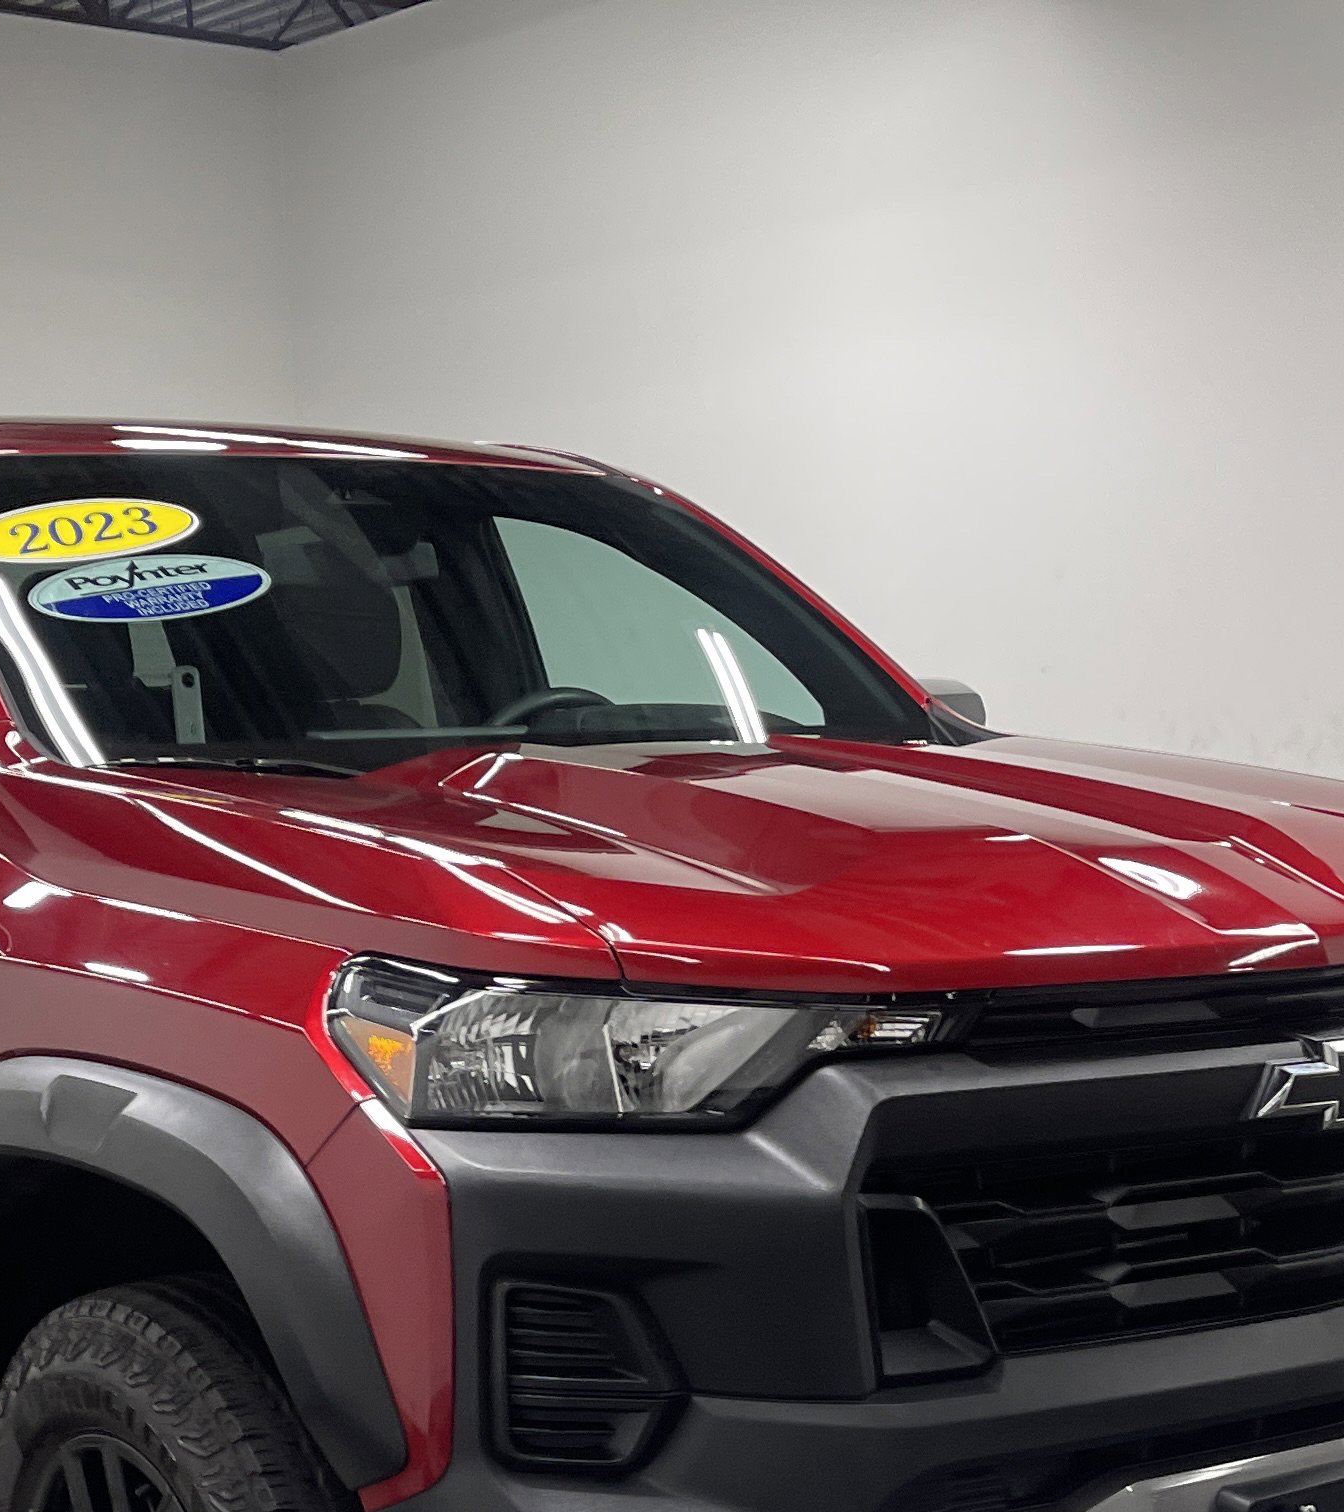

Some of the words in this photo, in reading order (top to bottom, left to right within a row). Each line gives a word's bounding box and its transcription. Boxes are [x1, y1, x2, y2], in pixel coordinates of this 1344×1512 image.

[9, 506, 159, 555] 2023
[64, 560, 209, 592] Poynter
[102, 581, 212, 605] PRO-CERTIFIED
[124, 591, 205, 610] WARRANTY
[137, 600, 211, 617] INCLUDED
